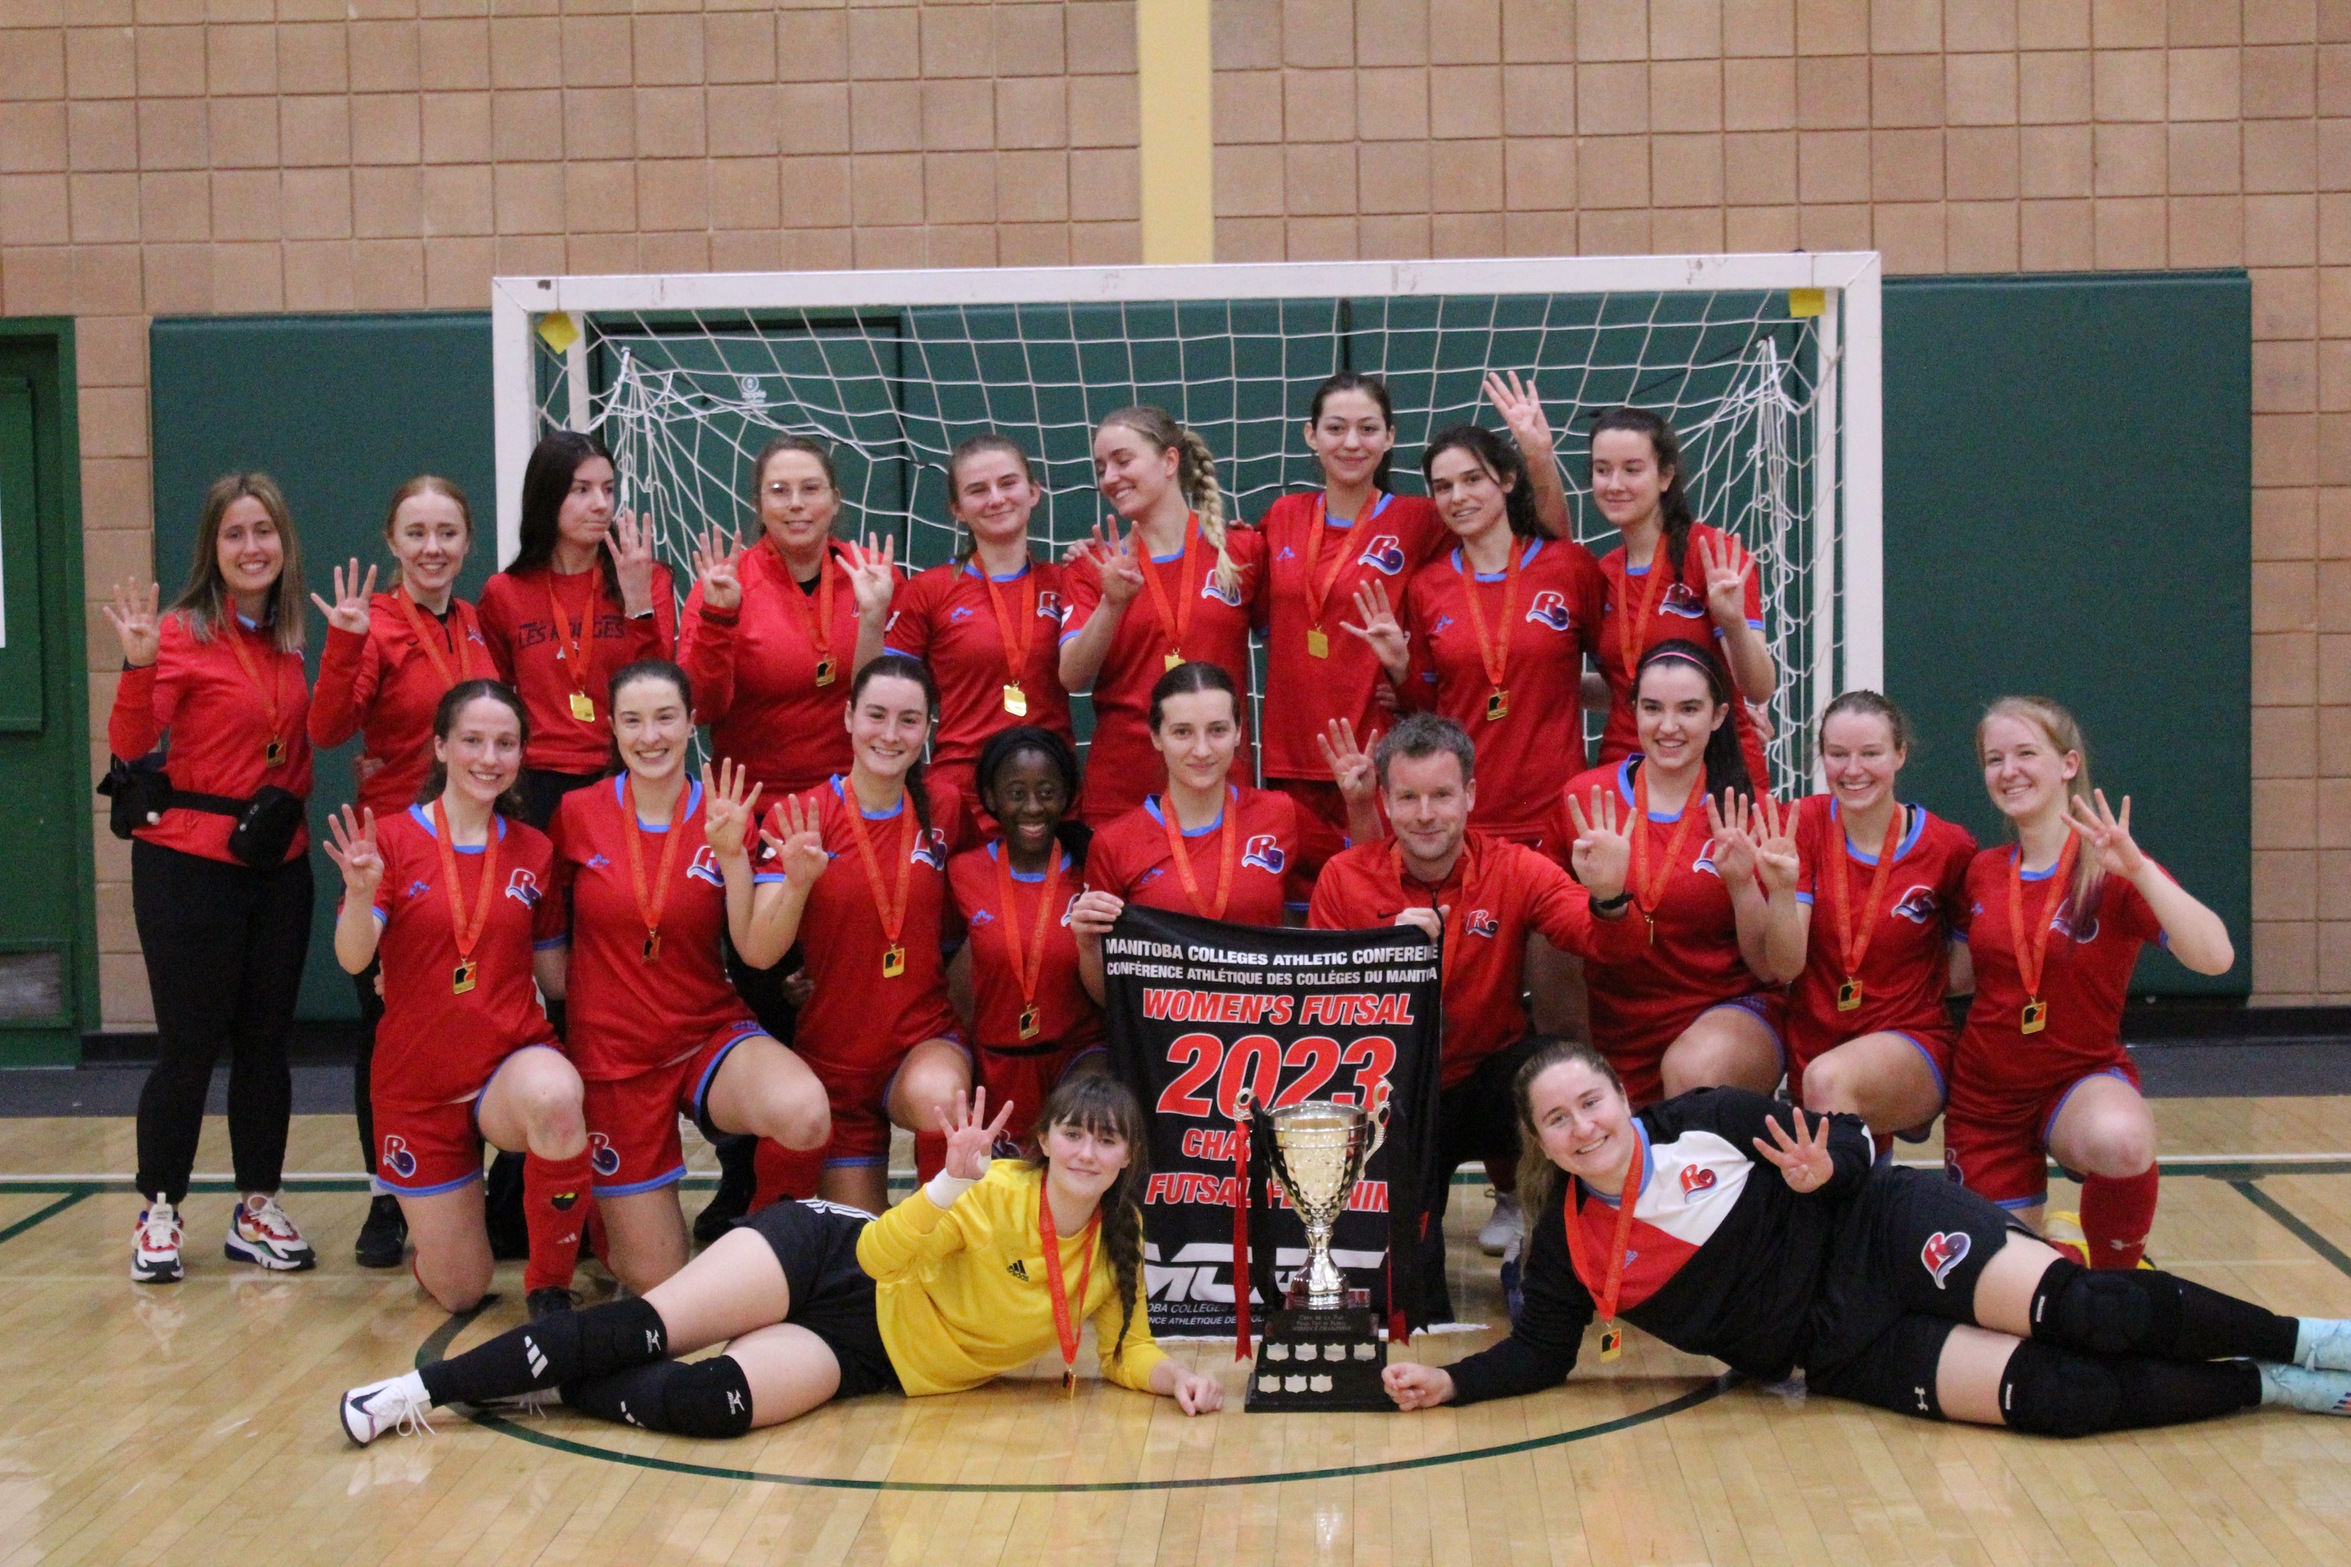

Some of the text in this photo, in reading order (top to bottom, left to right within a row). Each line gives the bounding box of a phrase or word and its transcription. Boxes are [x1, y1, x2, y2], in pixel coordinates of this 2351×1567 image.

[519, 622, 547, 648] LES
[1105, 938, 1438, 966] MANITOBA COLLEGES ATHLETIC CONFEREE
[1107, 961, 1183, 979] CONFÉRENCE
[1187, 968, 1263, 985] ATHLÉTIQUE
[1267, 972, 1292, 985] DES
[1364, 971, 1382, 983] DU
[1386, 967, 1437, 983] MANITA
[1143, 987, 1415, 1025] WOMEN'S FUTSAL
[1157, 1034, 1396, 1120] 2023
[1224, 1316, 1237, 1324] DE
